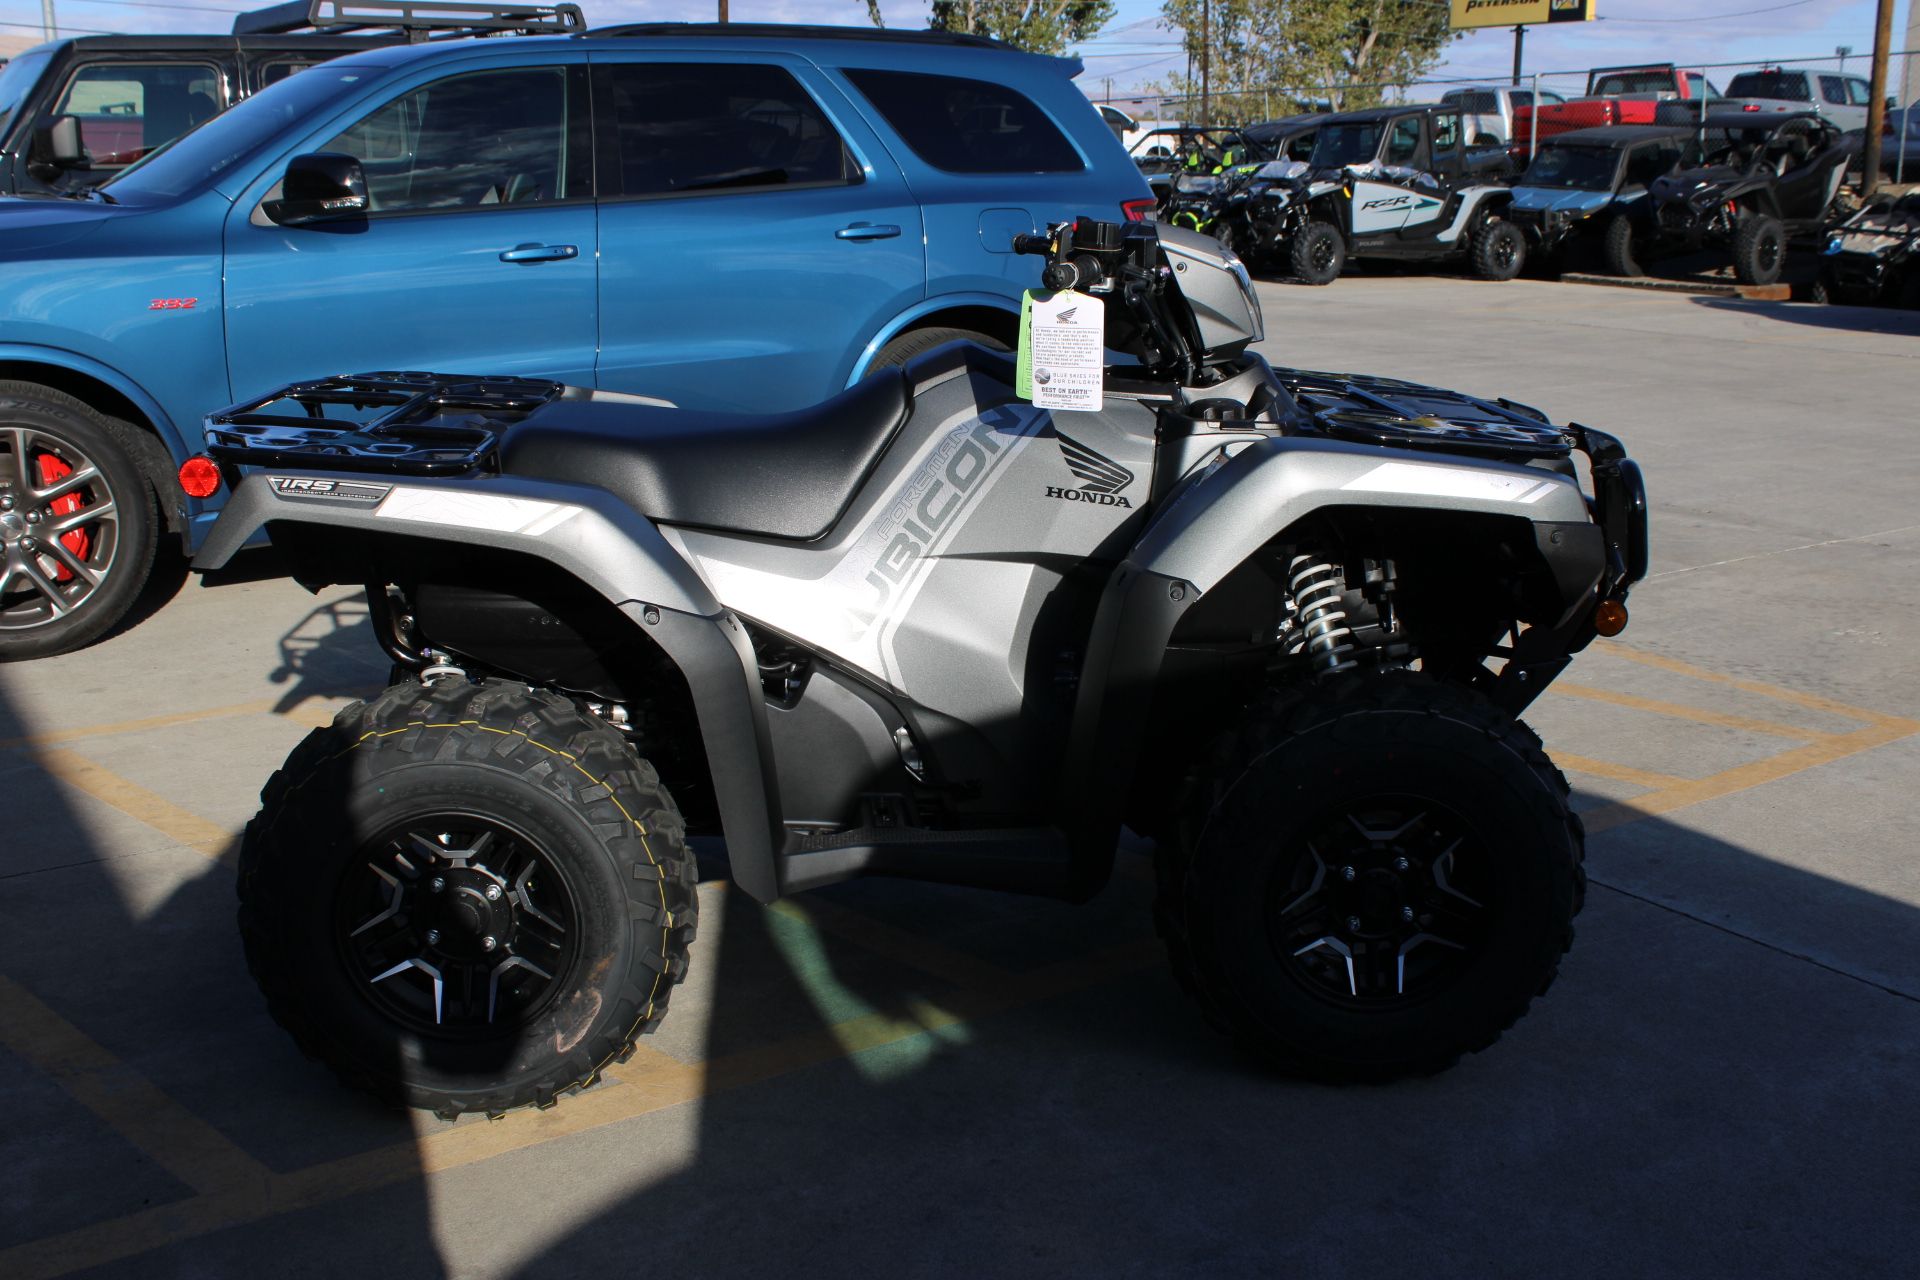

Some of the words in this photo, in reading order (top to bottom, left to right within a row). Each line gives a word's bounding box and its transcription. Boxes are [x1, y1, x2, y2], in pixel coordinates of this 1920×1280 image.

[1361, 196, 1410, 211] RZR
[148, 298, 197, 310] 392
[280, 479, 335, 491] IRS
[877, 423, 970, 540] FOREMAN
[1045, 486, 1133, 509] HONDA
[842, 406, 1023, 642] UBICON
